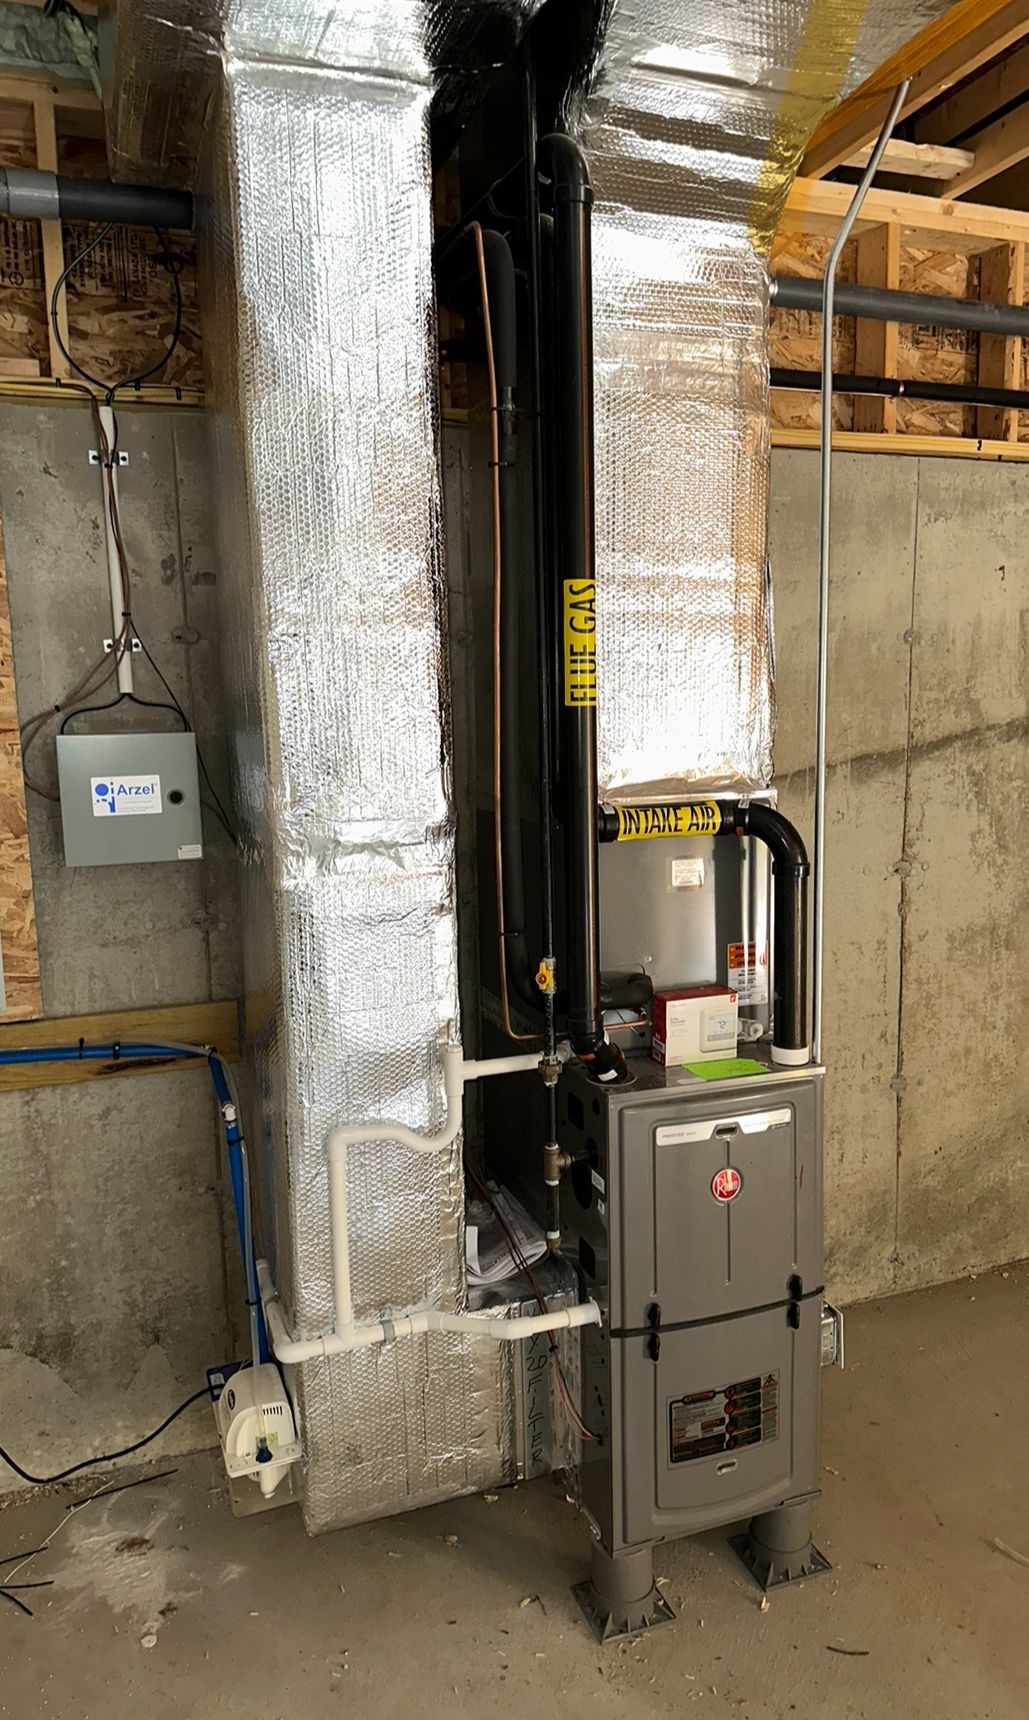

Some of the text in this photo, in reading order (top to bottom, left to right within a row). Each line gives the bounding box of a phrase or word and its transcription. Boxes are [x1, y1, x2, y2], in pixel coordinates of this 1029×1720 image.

[148, 255, 158, 278] OS
[568, 583, 597, 702] FLUE GAS
[117, 783, 155, 796] Arzel
[622, 805, 717, 835] INTAKE AIR
[527, 1372, 545, 1466] FILTER
